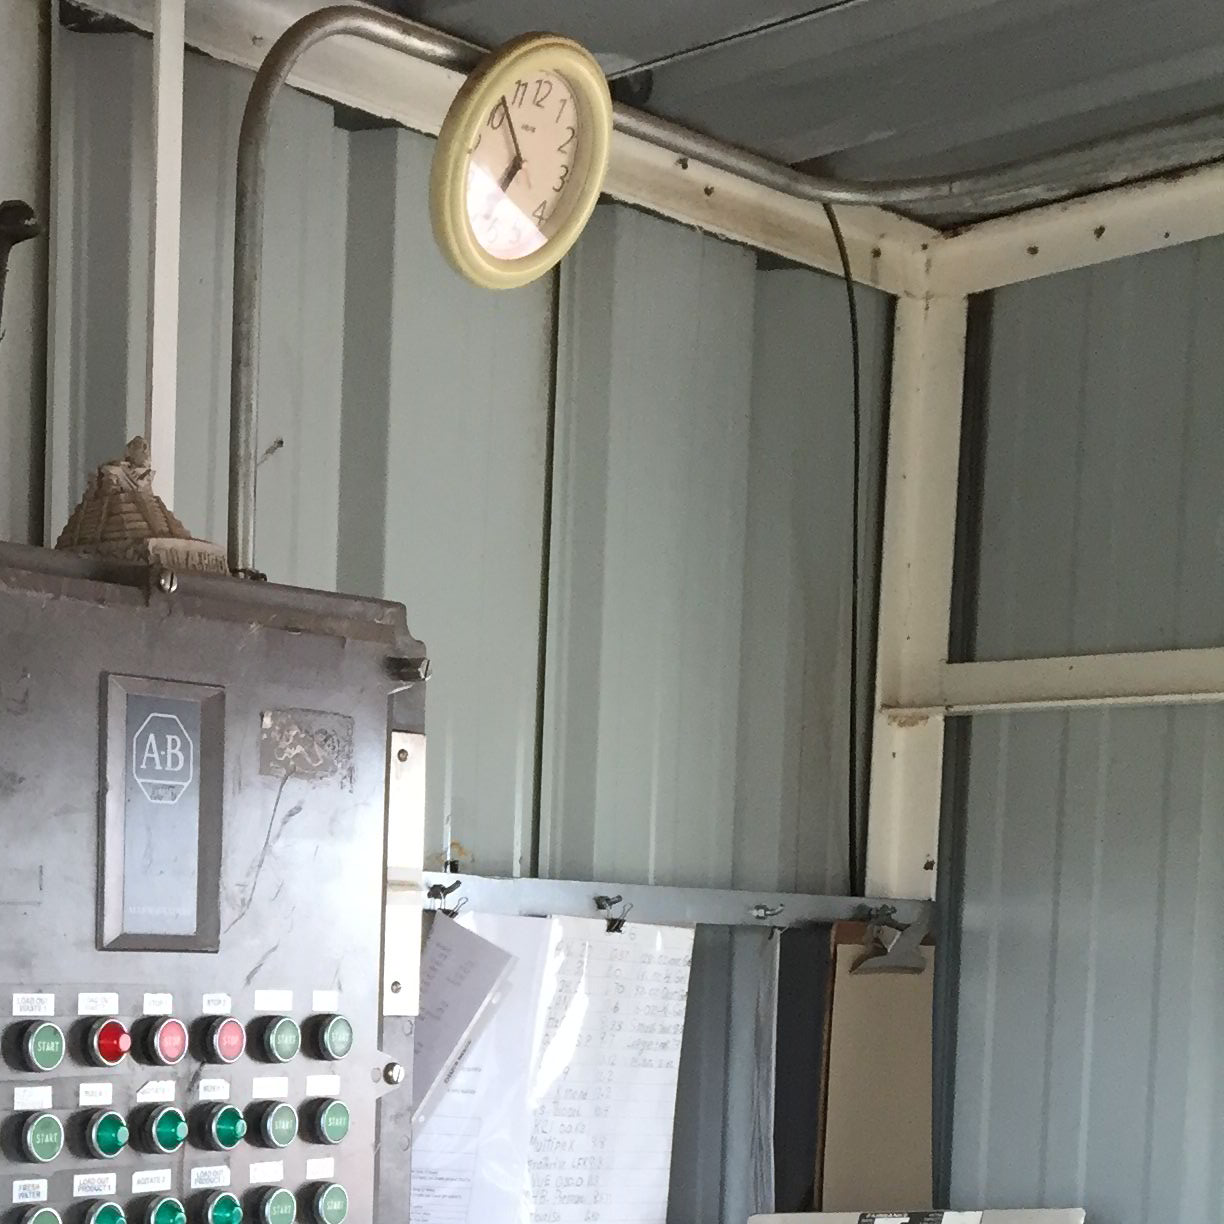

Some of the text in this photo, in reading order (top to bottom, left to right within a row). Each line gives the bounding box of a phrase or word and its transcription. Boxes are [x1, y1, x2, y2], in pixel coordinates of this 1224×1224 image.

[511, 79, 528, 108] 11
[532, 79, 553, 108] 12
[555, 99, 567, 123] 1
[557, 127, 575, 154] 2
[552, 164, 569, 193] 3
[532, 200, 549, 227] 4
[37, 1041, 60, 1053] START
[275, 1119, 294, 1131] START
[328, 1116, 347, 1127] START
[36, 1132, 59, 1144] START
[272, 1205, 292, 1216] START
[326, 1200, 345, 1210] START
